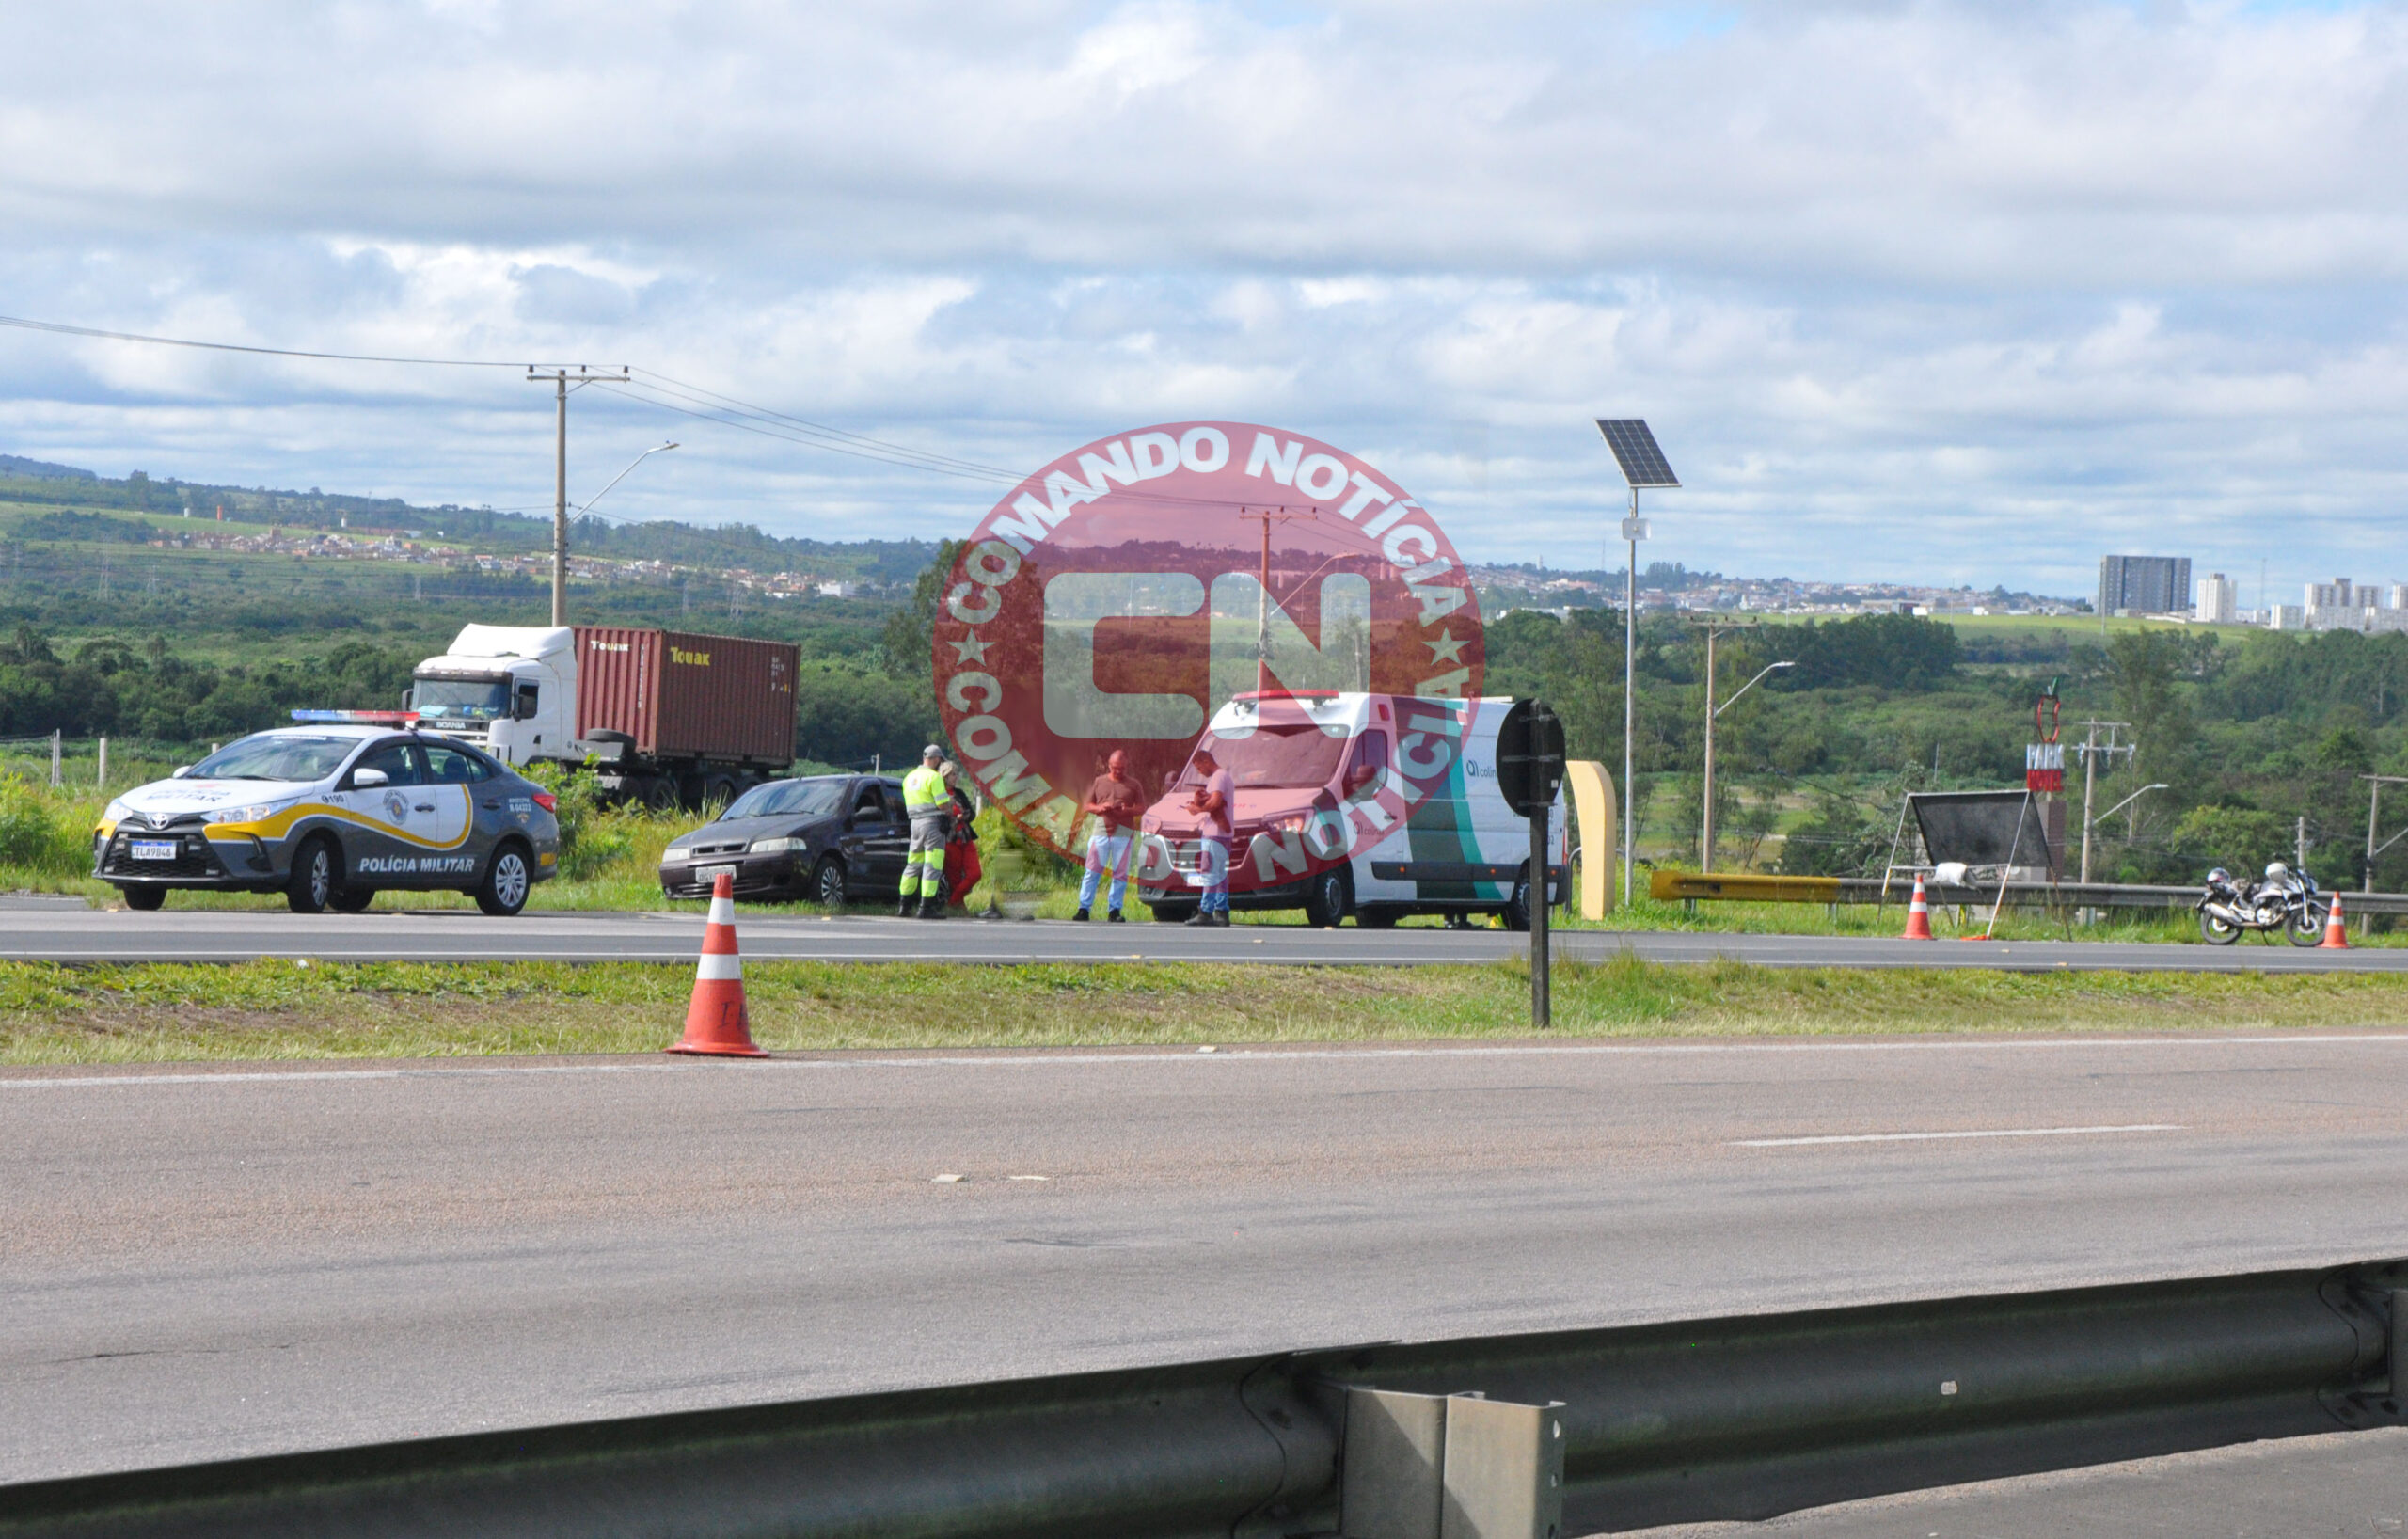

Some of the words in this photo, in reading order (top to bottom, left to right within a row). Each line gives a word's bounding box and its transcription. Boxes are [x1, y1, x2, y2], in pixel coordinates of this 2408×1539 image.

[436, 721, 467, 730] SCANIA
[2026, 743, 2066, 770] PARK
[359, 855, 417, 873] POLÍCIA
[420, 857, 475, 873] MILITAR
